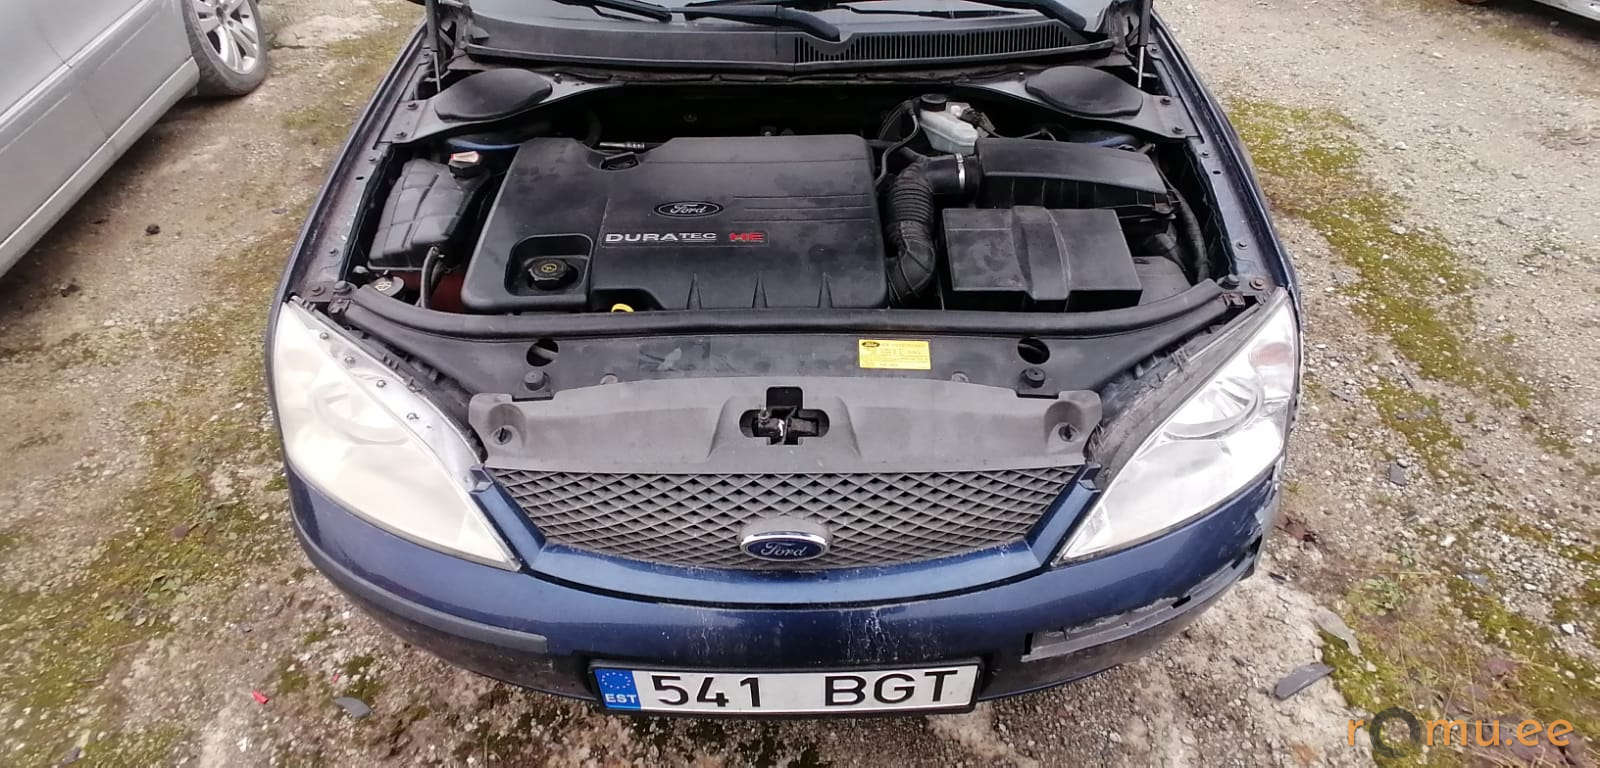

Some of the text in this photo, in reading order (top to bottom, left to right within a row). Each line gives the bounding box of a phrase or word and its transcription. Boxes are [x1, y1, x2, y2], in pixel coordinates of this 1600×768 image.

[669, 203, 707, 214] Ford
[605, 232, 717, 242] DURATEC
[761, 541, 807, 556] Ford
[651, 670, 958, 707] 541 BGT
[605, 693, 637, 704] EST
